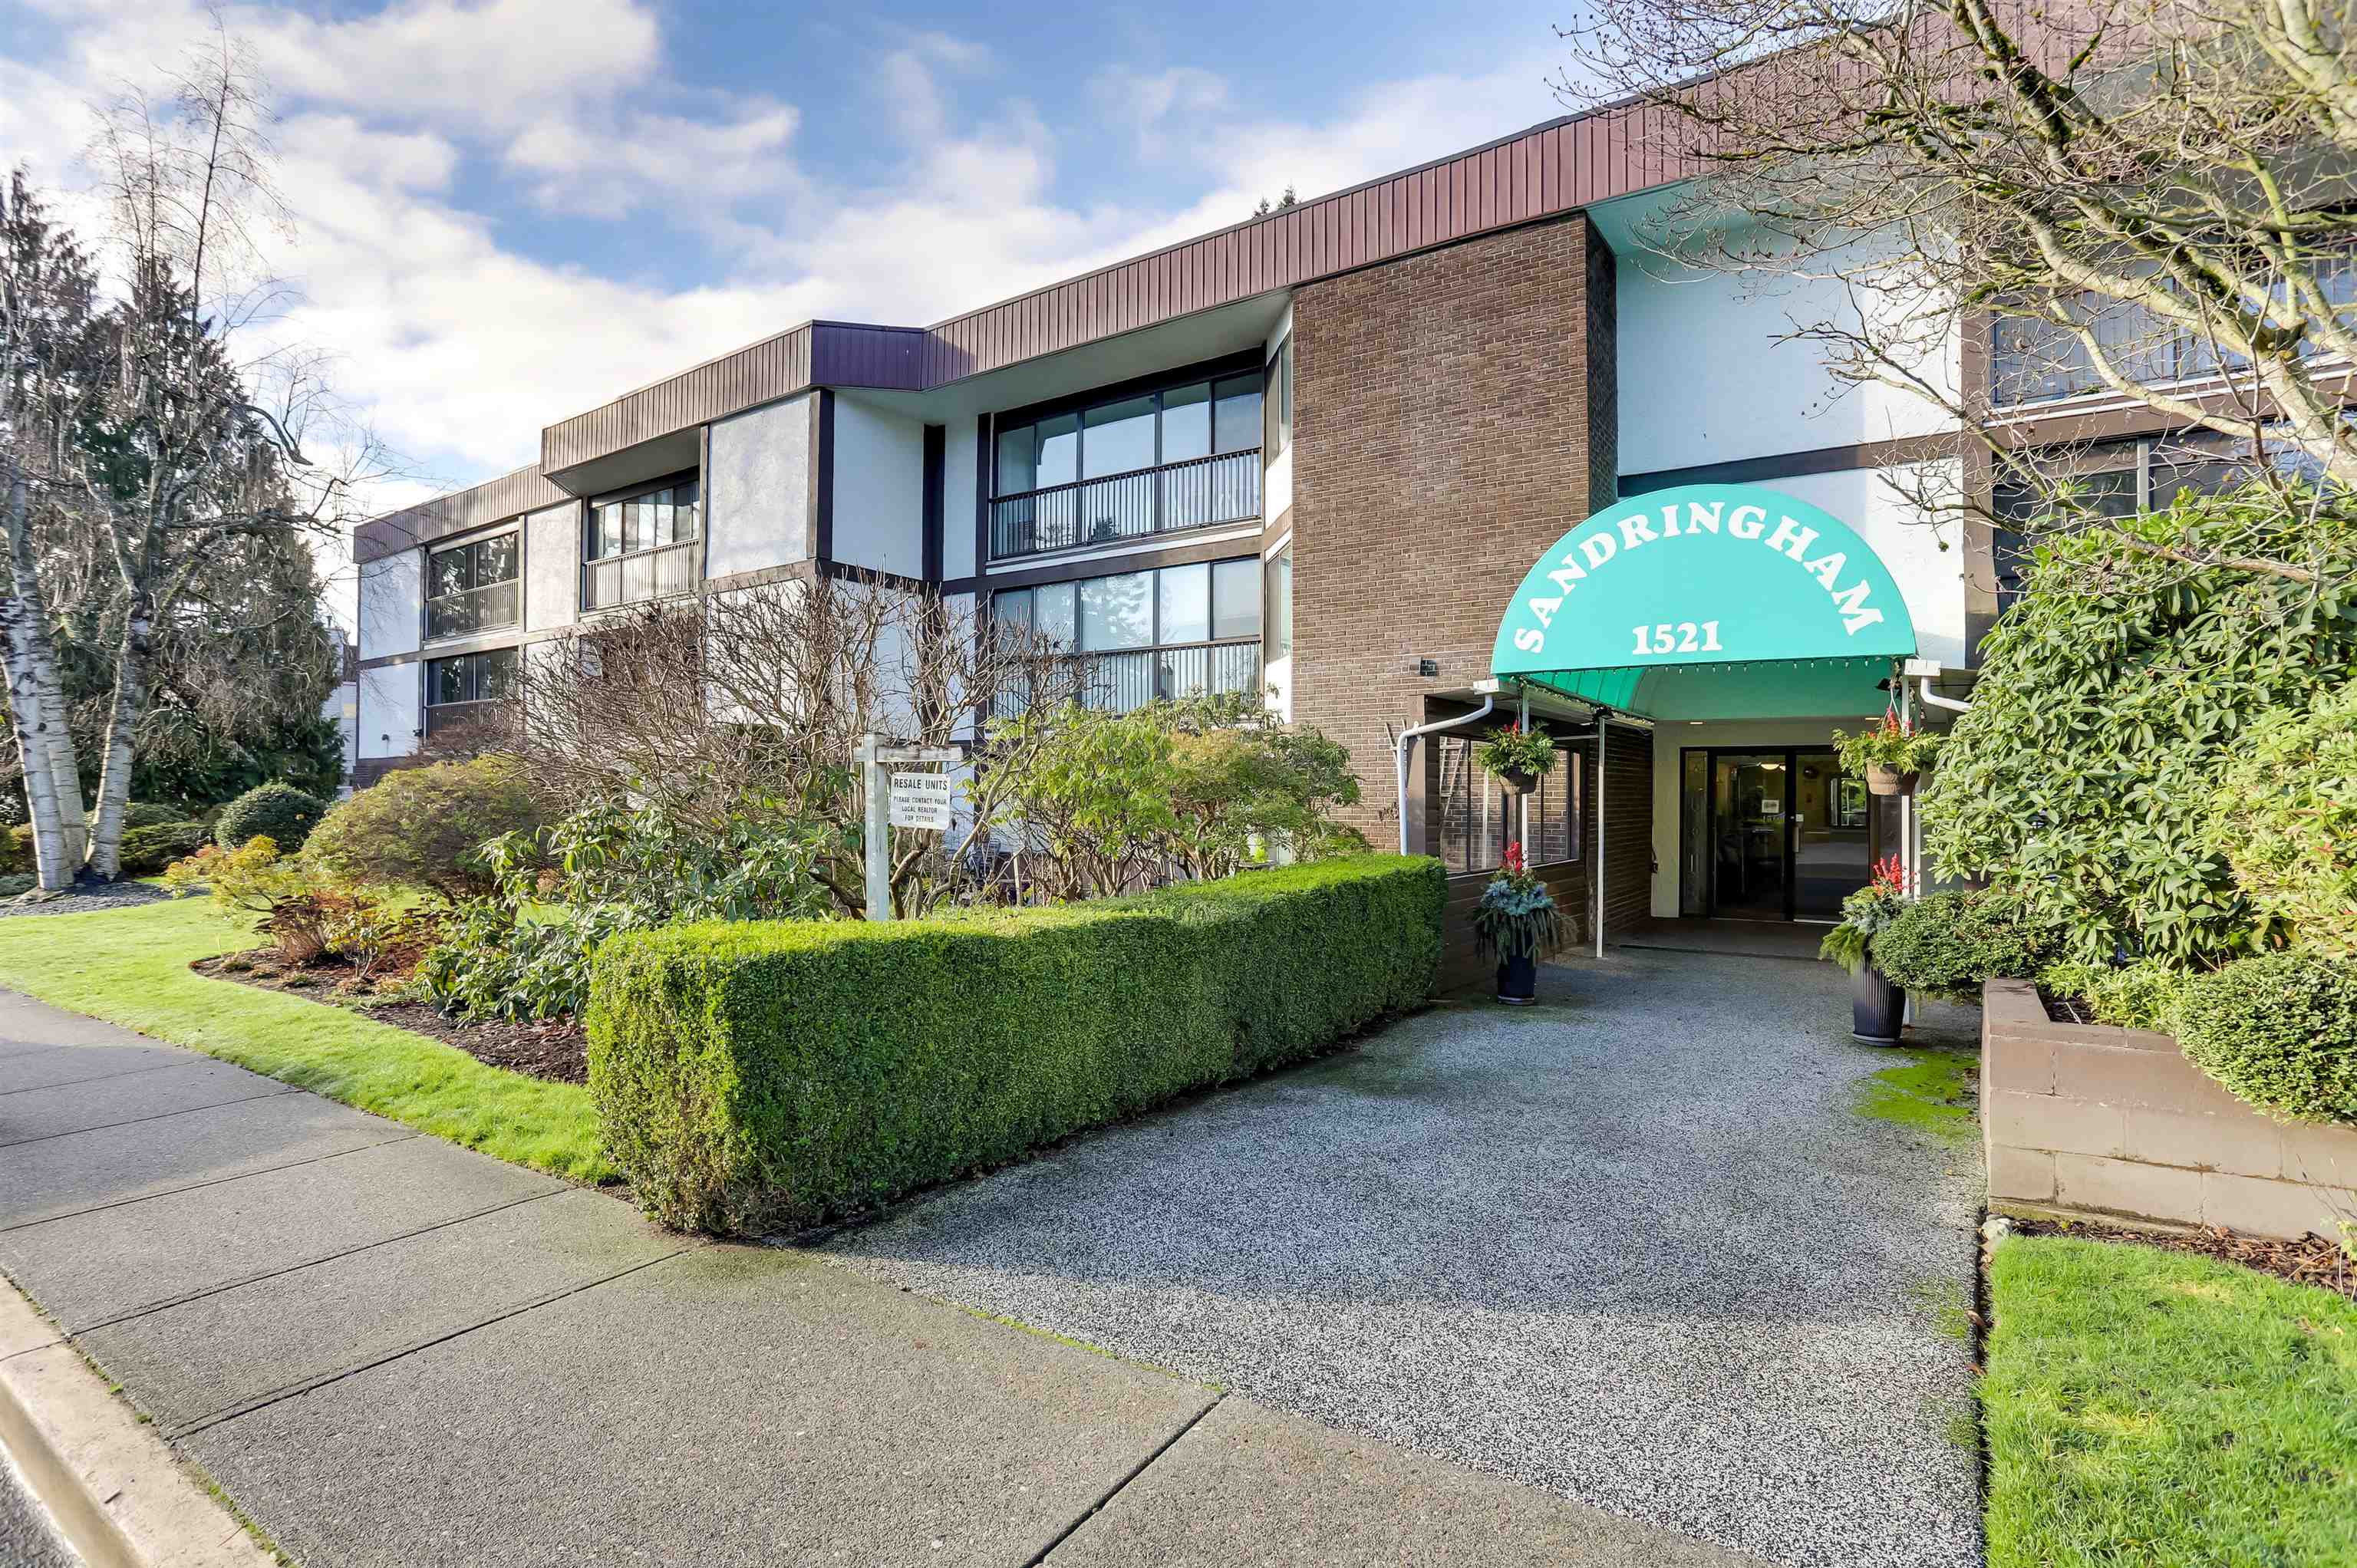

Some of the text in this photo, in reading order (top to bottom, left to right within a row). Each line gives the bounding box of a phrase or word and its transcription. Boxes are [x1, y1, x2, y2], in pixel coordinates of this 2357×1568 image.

[1514, 502, 1884, 654] SANDRINGHAM
[1631, 620, 1723, 656] 1521
[894, 778, 948, 791] RESALE UNITS
[911, 796, 933, 805] CONTACT
